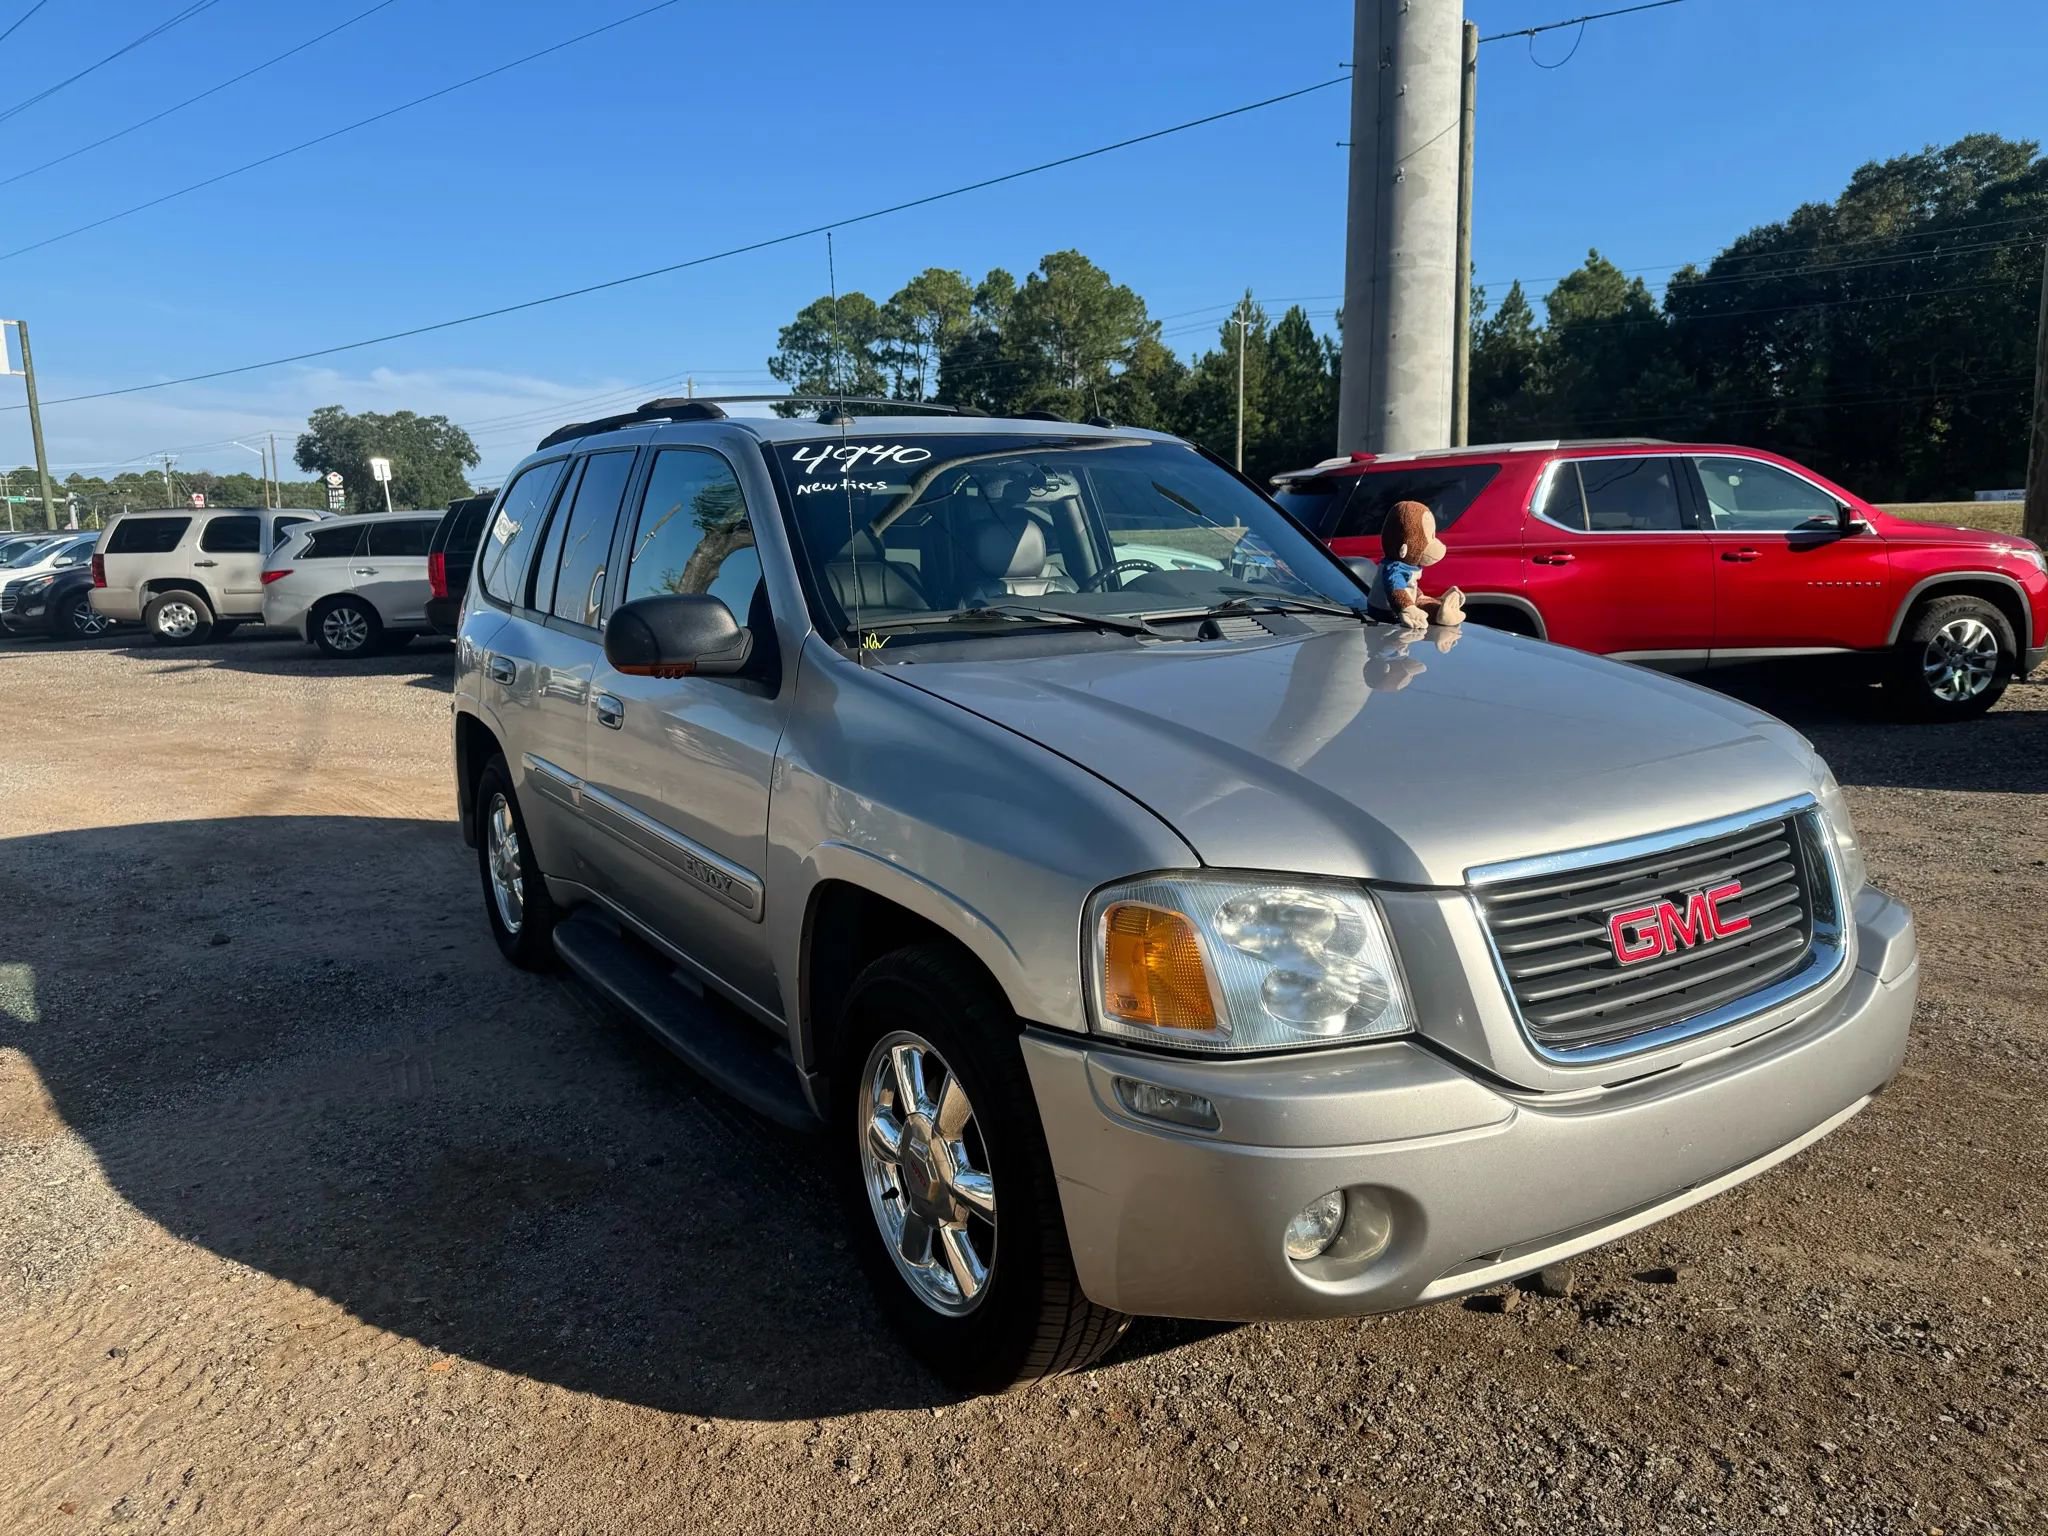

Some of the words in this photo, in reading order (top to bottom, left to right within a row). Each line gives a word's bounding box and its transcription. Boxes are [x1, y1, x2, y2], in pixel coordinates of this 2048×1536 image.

[792, 444, 932, 474] 4940
[796, 482, 838, 495] New
[685, 858, 732, 893] ENVOY
[1608, 880, 1752, 966] GMC
